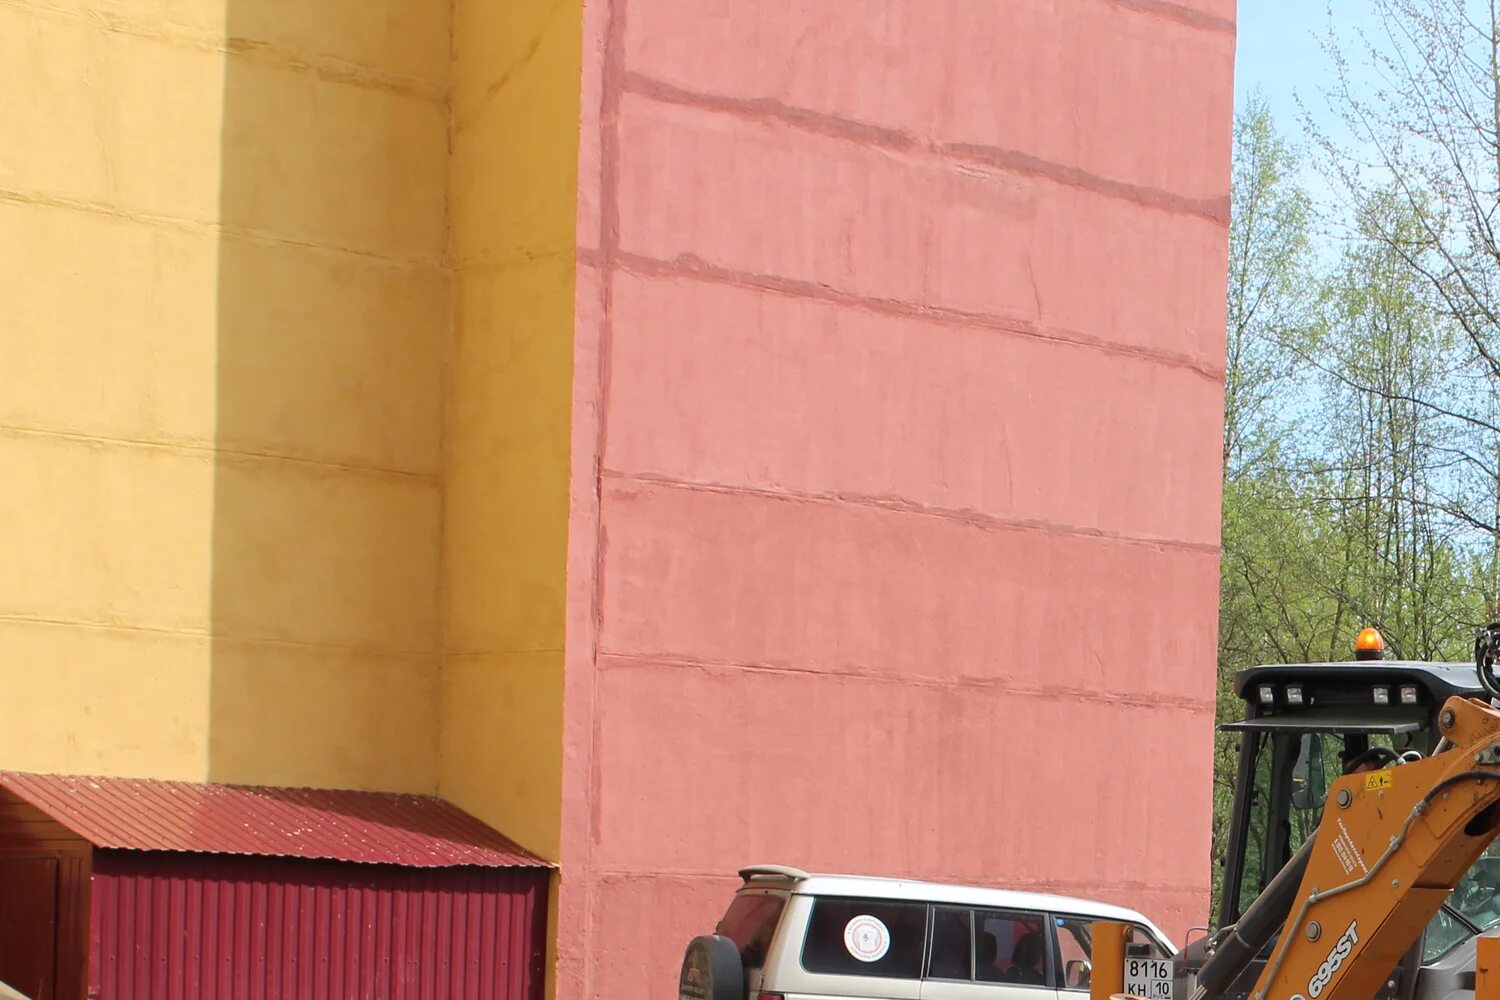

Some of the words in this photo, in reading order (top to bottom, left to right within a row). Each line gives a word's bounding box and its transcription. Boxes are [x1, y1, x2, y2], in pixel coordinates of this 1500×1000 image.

[1307, 918, 1360, 999] 695ST
[1130, 961, 1167, 978] 8116
[1155, 981, 1170, 995] 10
